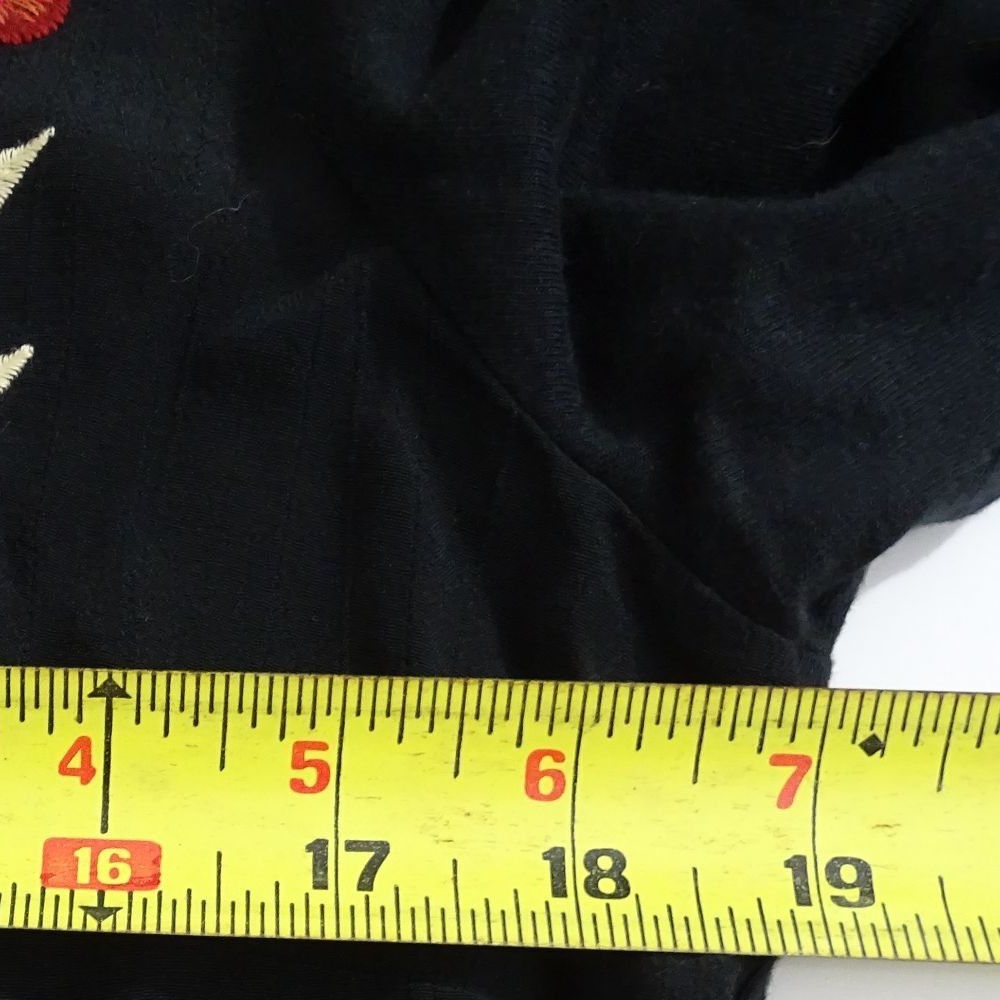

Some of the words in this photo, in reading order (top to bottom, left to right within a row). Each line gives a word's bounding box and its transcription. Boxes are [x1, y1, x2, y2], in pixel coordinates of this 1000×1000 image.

[58, 735, 96, 785] 4
[289, 740, 331, 794] 5
[524, 748, 566, 802] 6
[769, 753, 813, 809] 7
[73, 846, 132, 885] 16
[305, 838, 391, 892] 17
[541, 846, 631, 900] 18
[783, 854, 876, 908] 19
